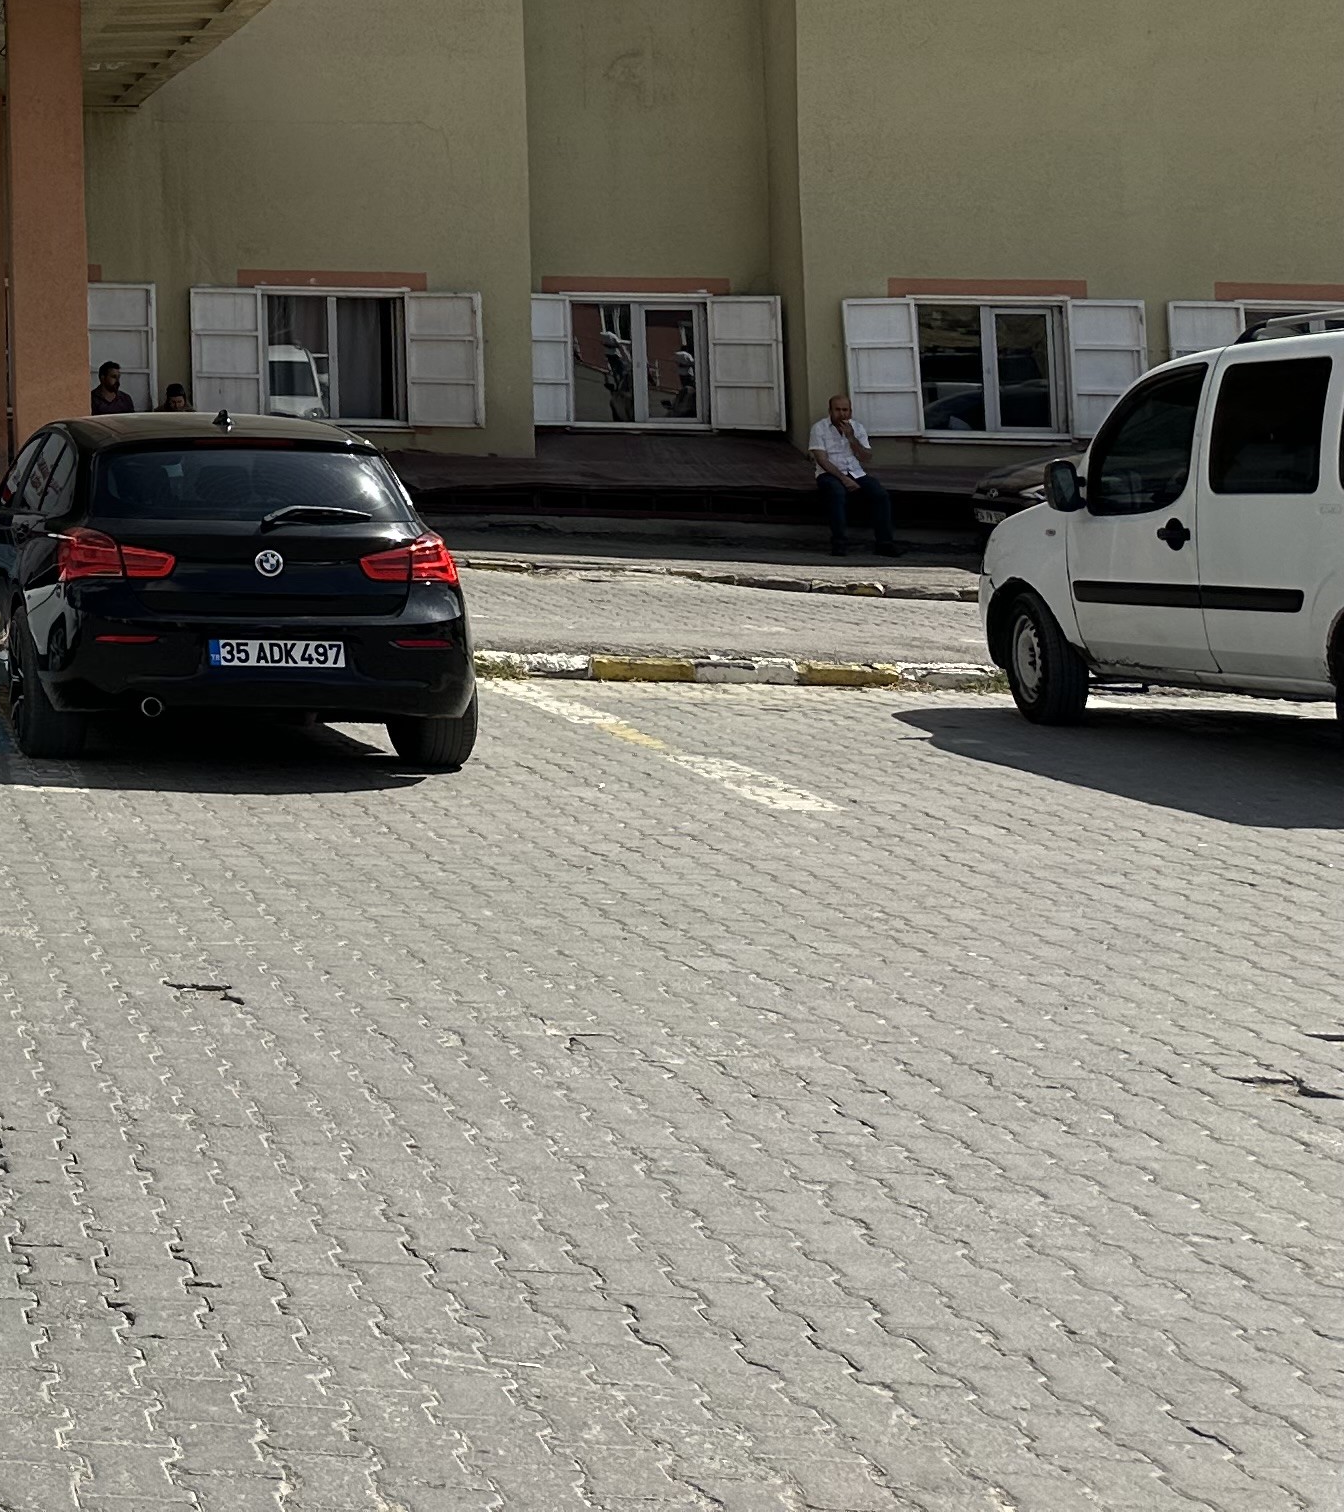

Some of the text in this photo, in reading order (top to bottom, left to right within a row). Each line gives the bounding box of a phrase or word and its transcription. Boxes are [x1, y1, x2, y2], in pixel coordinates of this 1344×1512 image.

[221, 642, 250, 663] 35
[256, 642, 298, 664] ADK
[300, 643, 342, 665] 497
